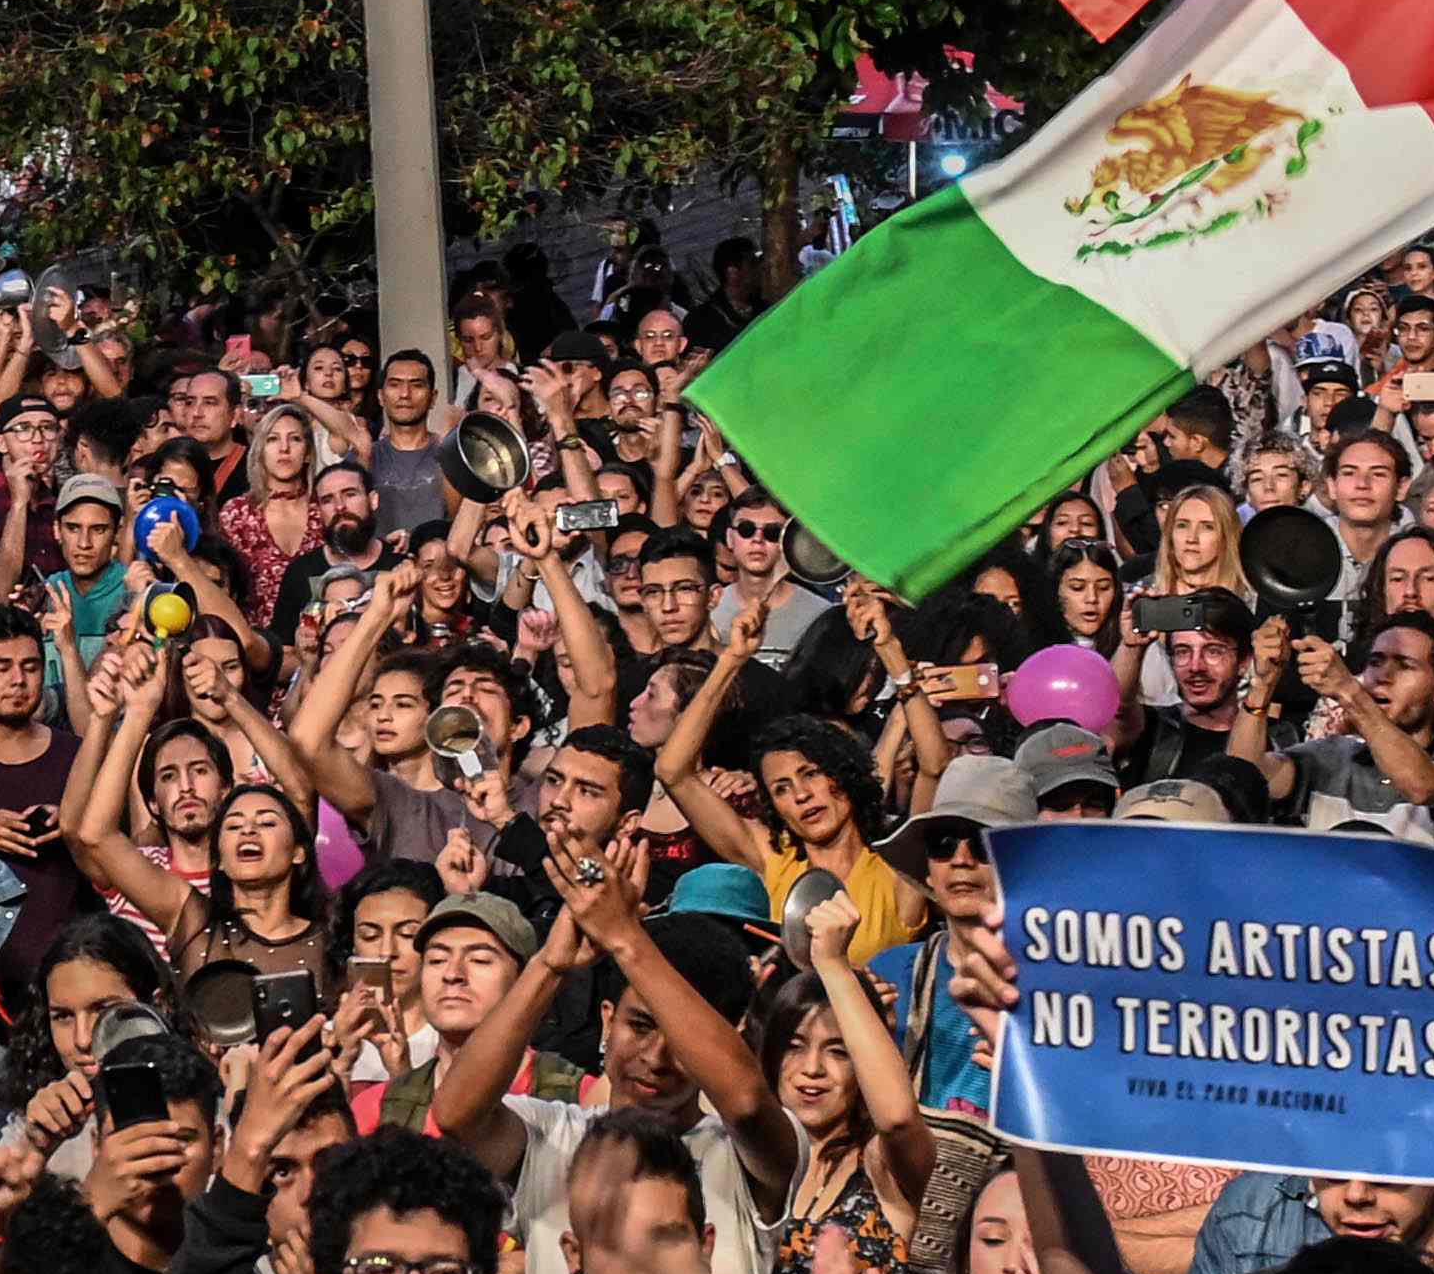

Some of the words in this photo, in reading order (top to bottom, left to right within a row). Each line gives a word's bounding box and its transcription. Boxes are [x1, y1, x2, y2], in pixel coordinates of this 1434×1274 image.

[1024, 906, 1185, 972] SOMOS
[1033, 990, 1094, 1049] NO
[1128, 1077, 1168, 1097] VIVA
[1176, 1082, 1197, 1100] EL
[1204, 1087, 1249, 1106] PARO
[1257, 1091, 1347, 1114] NACIONAL
